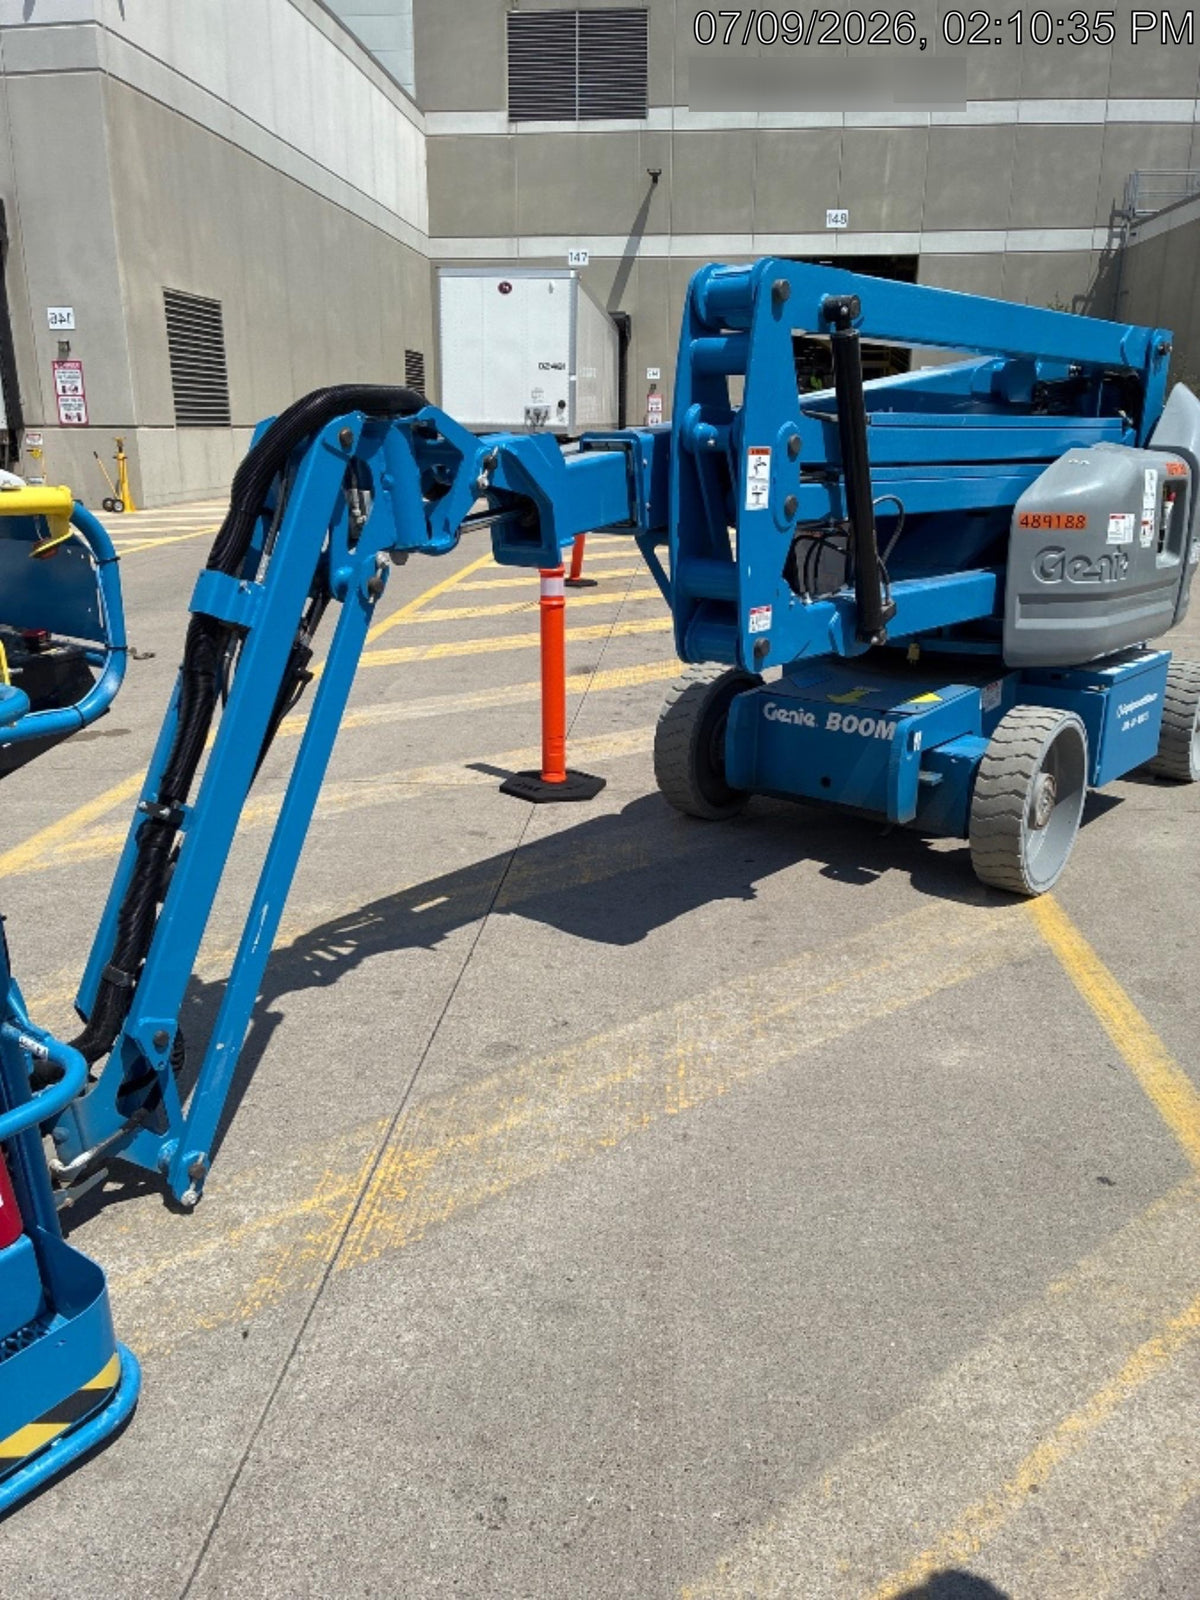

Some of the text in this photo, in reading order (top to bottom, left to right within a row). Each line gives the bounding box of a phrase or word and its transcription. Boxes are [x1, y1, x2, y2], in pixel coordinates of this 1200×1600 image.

[828, 212, 847, 225] 148
[569, 251, 588, 262] 147
[1020, 514, 1086, 529] 489188
[763, 701, 897, 740] Genie BOOM
